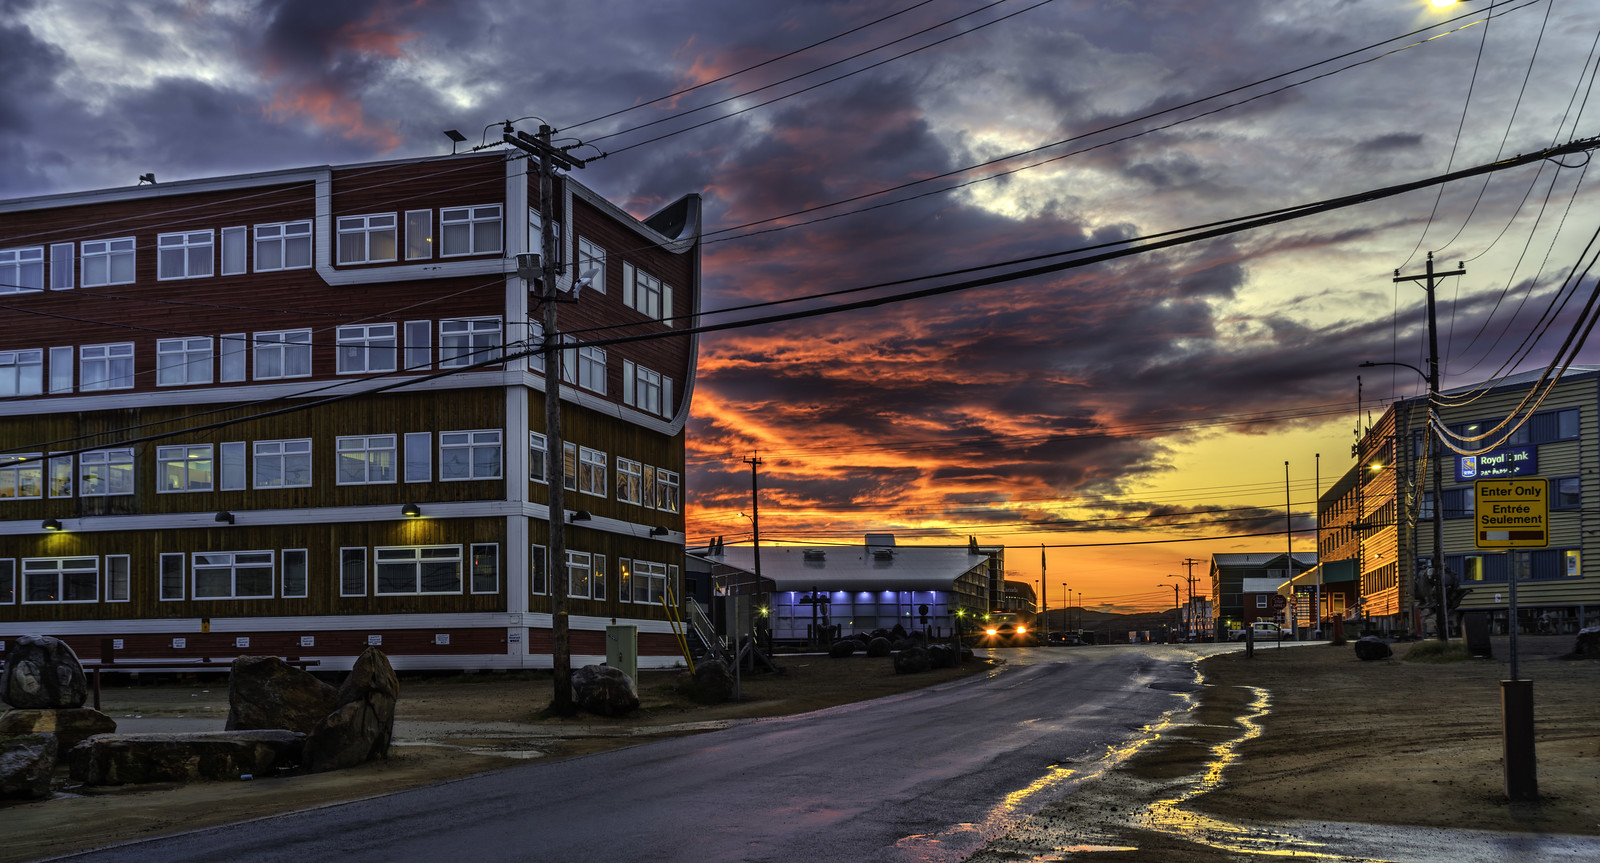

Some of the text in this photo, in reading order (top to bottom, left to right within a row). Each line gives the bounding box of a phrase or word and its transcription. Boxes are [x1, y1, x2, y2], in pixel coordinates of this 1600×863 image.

[1480, 453, 1504, 466] Royal
[1481, 486, 1541, 497] Enter Only
[1493, 505, 1530, 514] Entrée
[1481, 515, 1542, 524] Seulement
